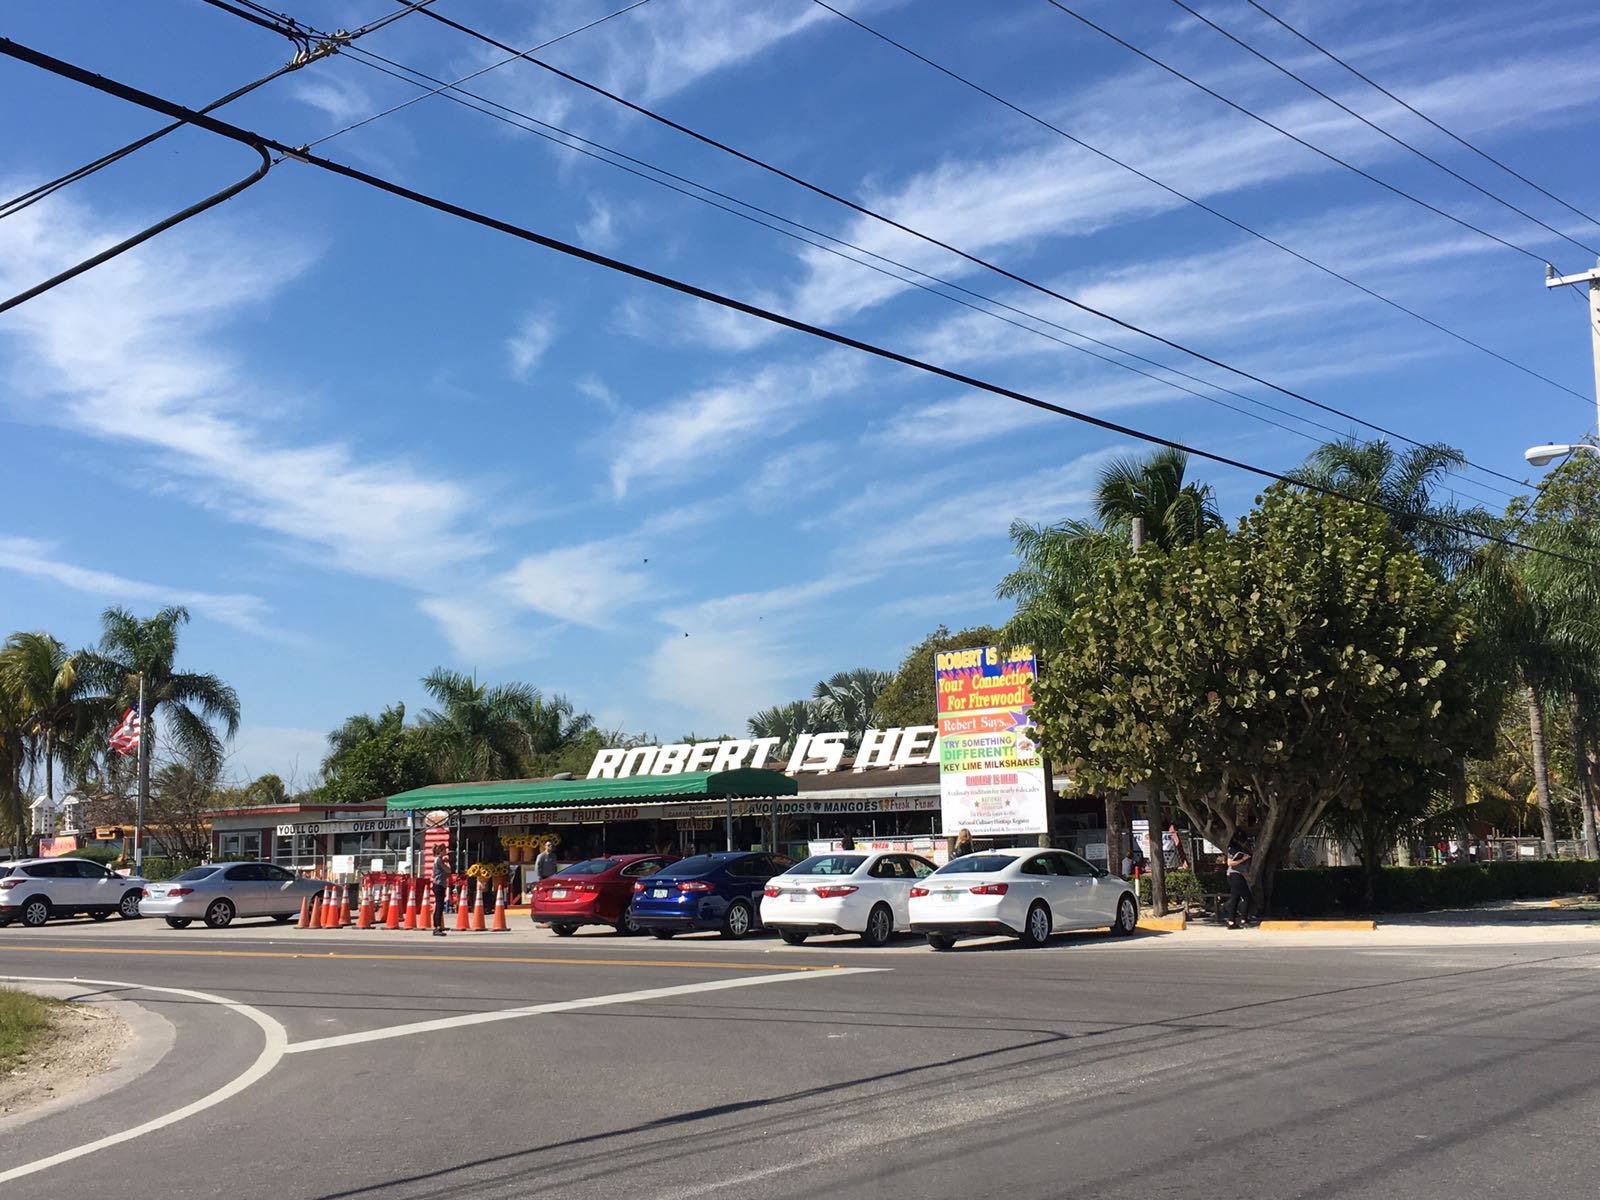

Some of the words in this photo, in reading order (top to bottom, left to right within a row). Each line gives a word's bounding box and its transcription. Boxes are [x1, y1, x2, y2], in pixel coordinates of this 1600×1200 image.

[937, 649, 982, 671] ROBERT
[986, 646, 997, 665] IS
[938, 677, 964, 694] Your
[972, 669, 1033, 689] Connection
[947, 695, 967, 711] For
[968, 686, 1025, 709] Firewood!
[944, 718, 976, 732] Robert
[944, 740, 959, 749] TRY
[962, 736, 1012, 748] SOMETHING
[586, 736, 780, 780] ROBERT
[787, 731, 850, 776] IS
[852, 724, 940, 774] HE
[944, 746, 1014, 761] DIFFERENT!
[943, 763, 960, 772] KEY
[962, 761, 982, 771] LIME
[984, 757, 1040, 769] MILKSHAKES
[824, 799, 878, 813] MANGOES
[479, 814, 516, 825] ROBERT
[519, 814, 529, 824] IS
[572, 810, 601, 822] FRUIT
[604, 808, 639, 820] STAND
[308, 824, 320, 834] GO
[353, 821, 376, 832] OVER
[377, 819, 396, 830] OUR
